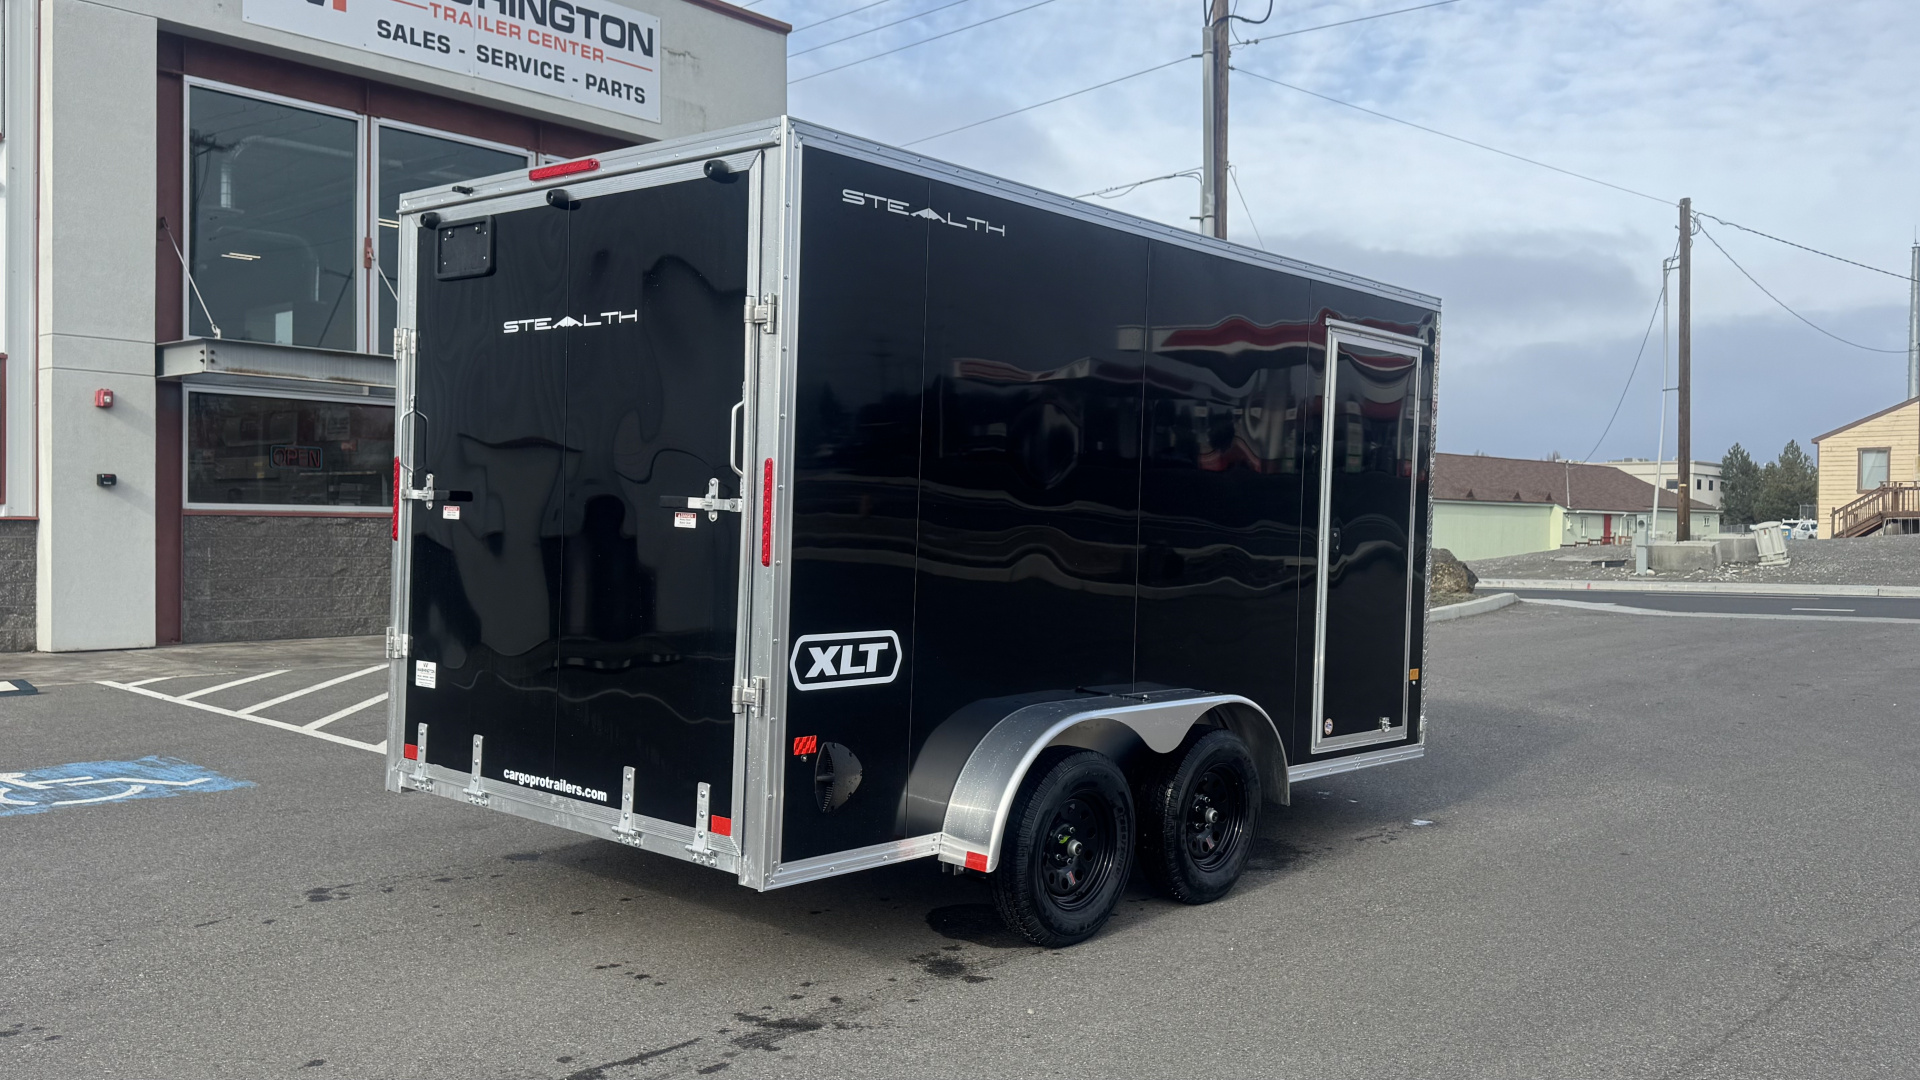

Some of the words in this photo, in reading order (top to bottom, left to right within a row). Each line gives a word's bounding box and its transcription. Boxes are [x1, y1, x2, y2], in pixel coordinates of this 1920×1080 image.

[429, 2, 521, 40] TRAILER
[527, 29, 604, 63] CENTER
[451, 0, 653, 58] INGTON
[377, 19, 451, 54] SALES
[476, 44, 565, 83] SERVICE
[585, 73, 646, 104] PARTS
[273, 448, 320, 468] OPEN
[804, 642, 889, 678] XLT
[503, 768, 607, 802] cargoprotrailers.com
